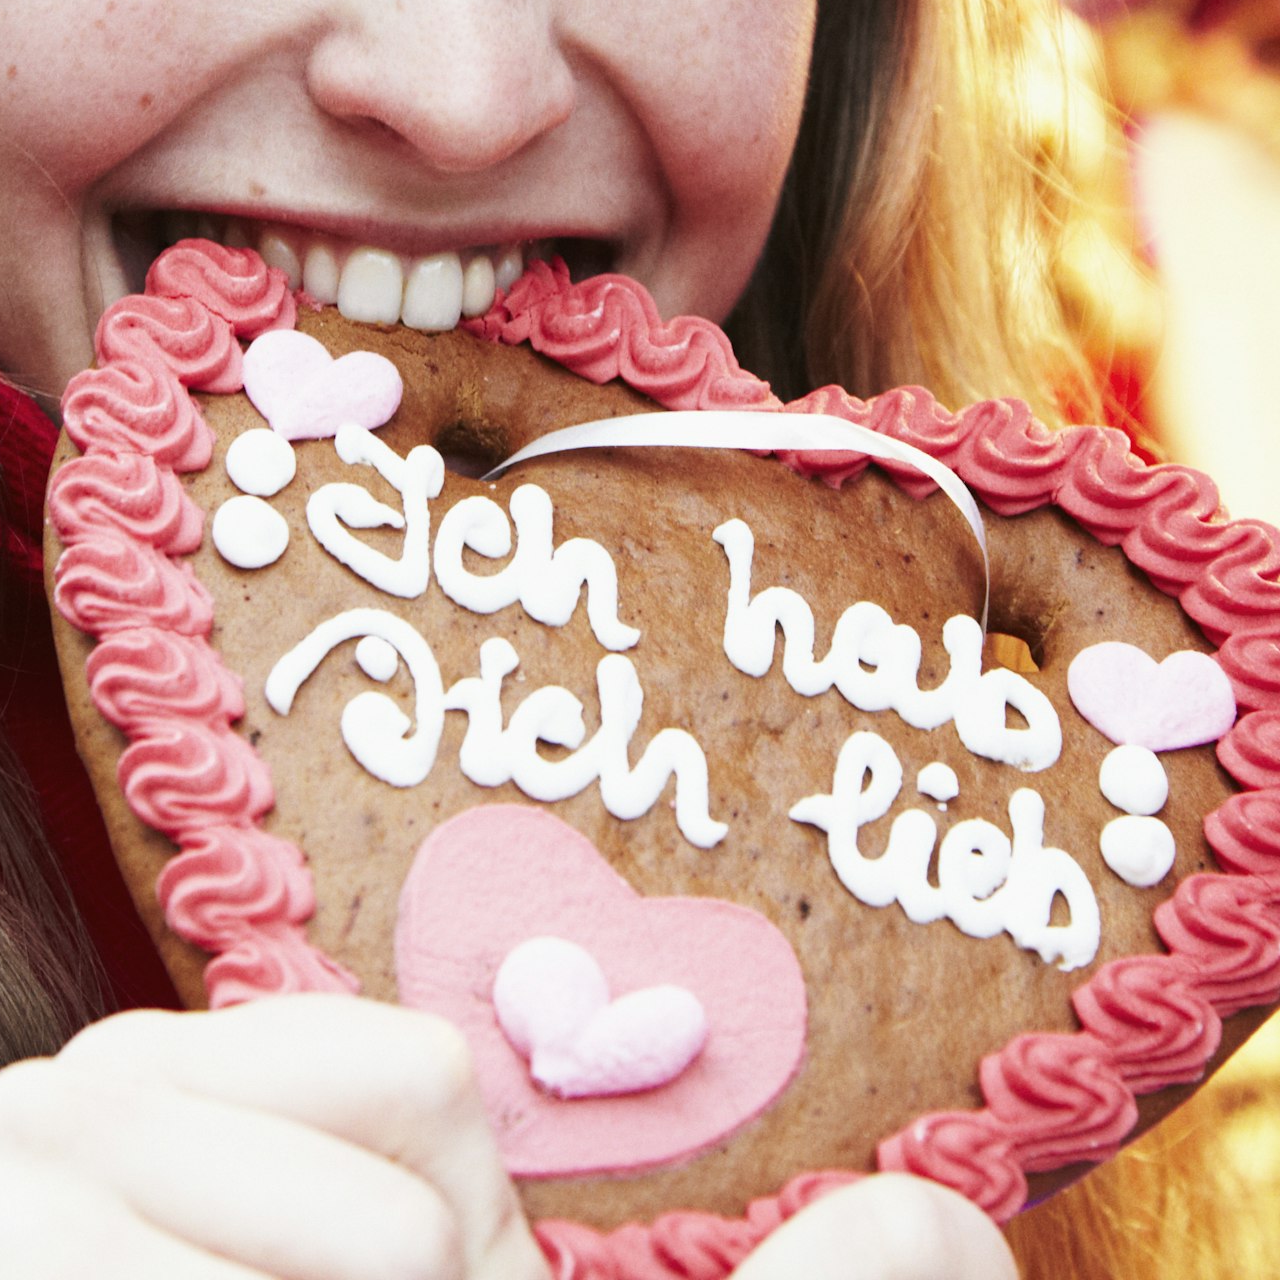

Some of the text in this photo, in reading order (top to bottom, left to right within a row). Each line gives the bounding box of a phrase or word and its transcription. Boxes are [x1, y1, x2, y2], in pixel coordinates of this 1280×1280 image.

[308, 425, 1061, 770] Ich hab
[266, 609, 1099, 969] Dich lieb
